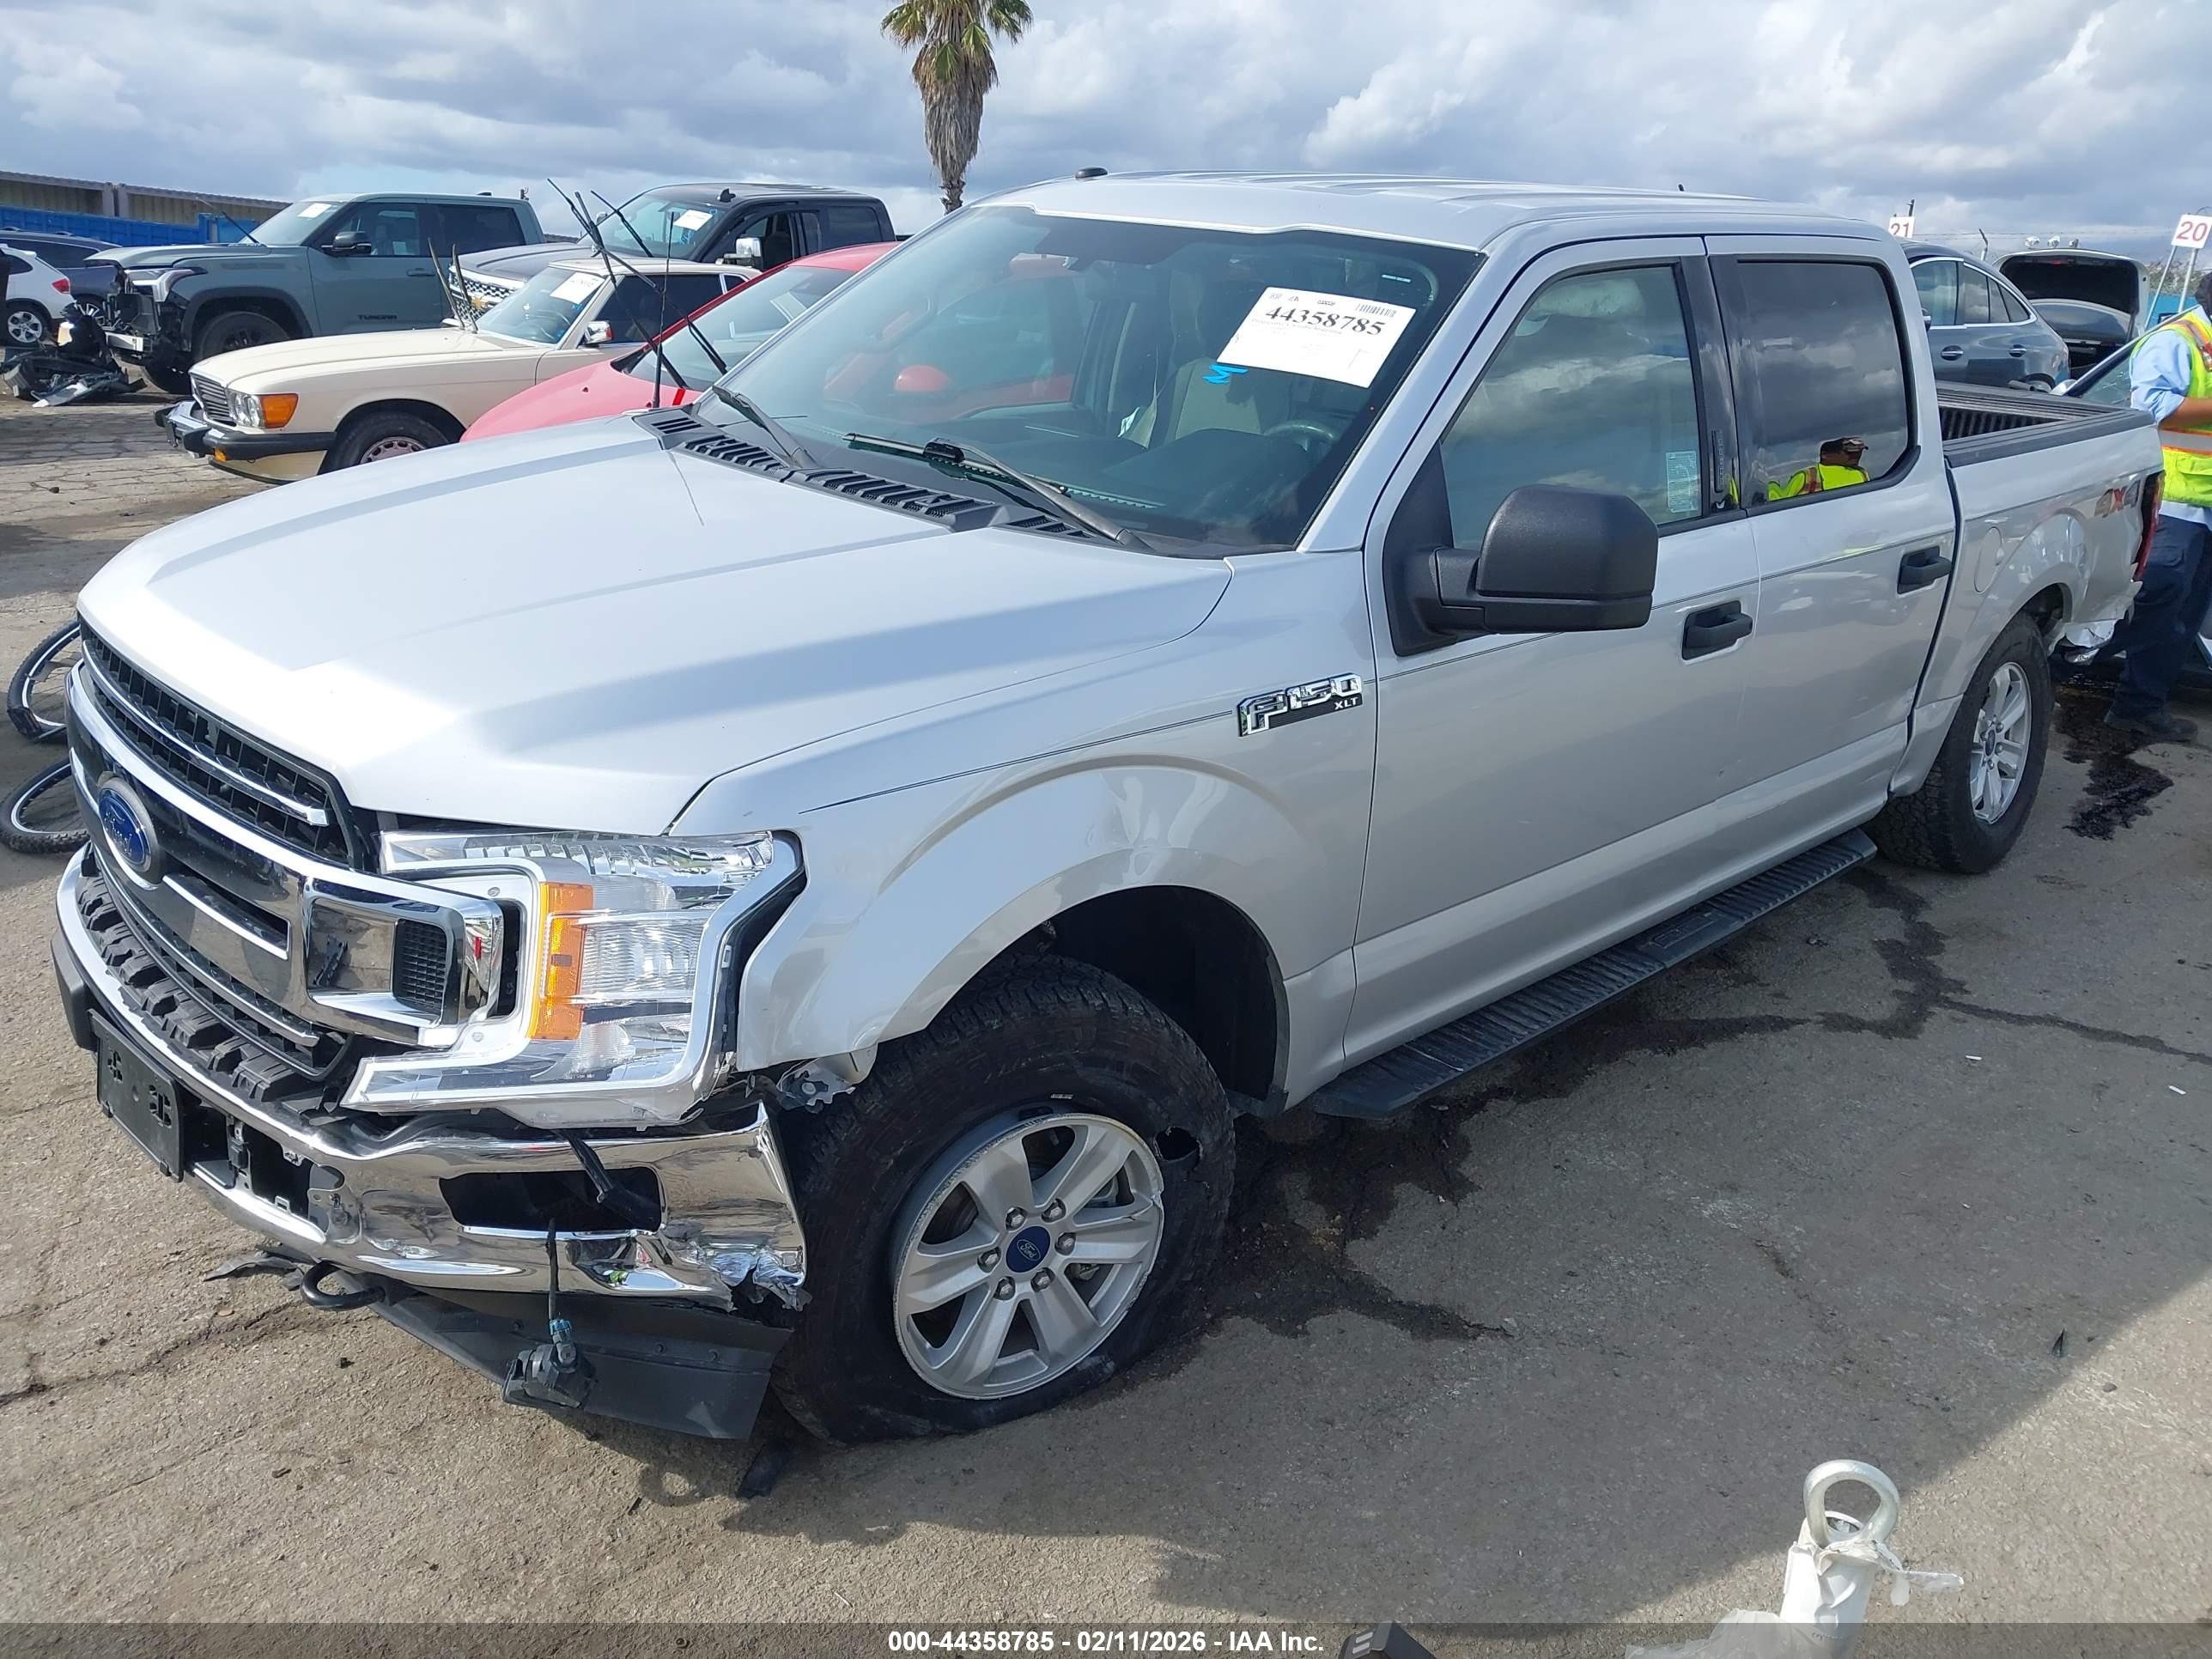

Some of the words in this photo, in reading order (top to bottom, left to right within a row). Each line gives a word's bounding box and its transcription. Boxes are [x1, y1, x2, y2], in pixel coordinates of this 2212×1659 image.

[1891, 222, 1910, 238] 21
[2176, 221, 2208, 241] 20
[1265, 305, 1386, 336] 44358785
[1334, 696, 1358, 711] XLT
